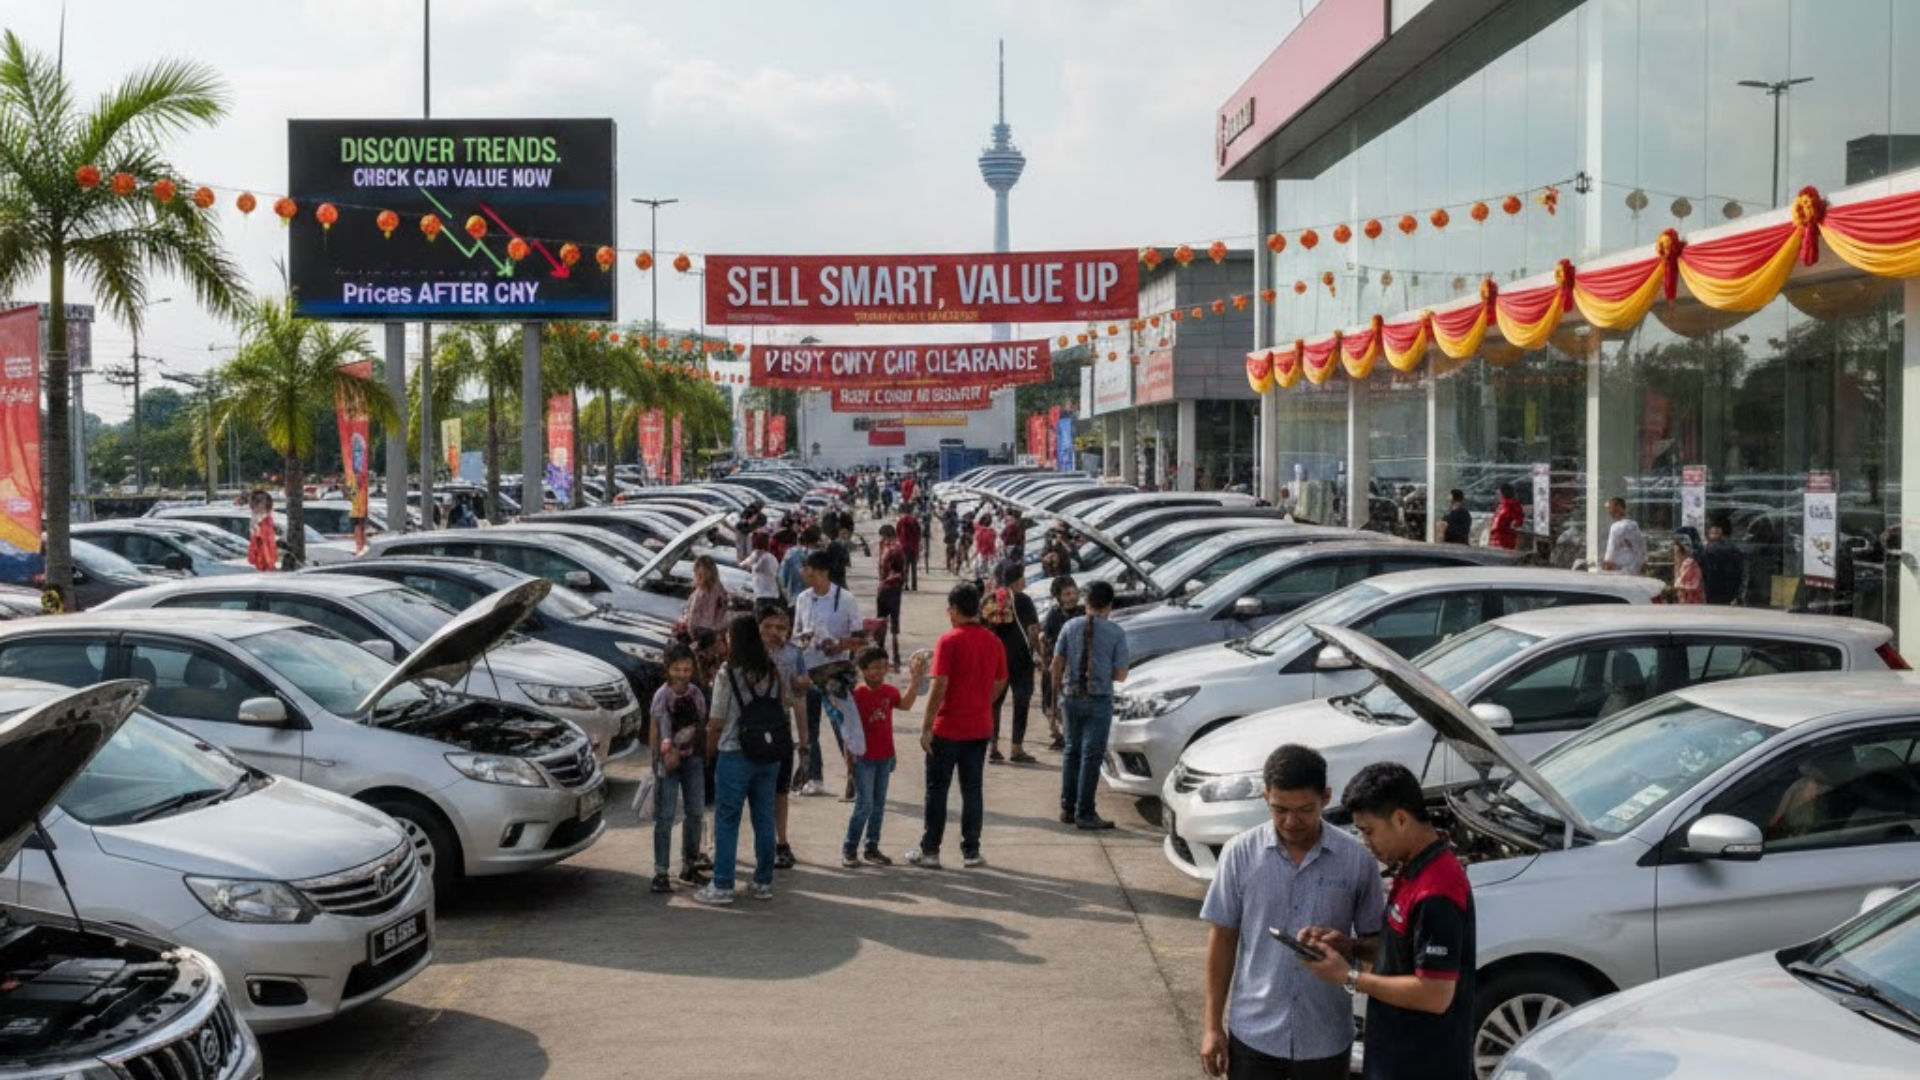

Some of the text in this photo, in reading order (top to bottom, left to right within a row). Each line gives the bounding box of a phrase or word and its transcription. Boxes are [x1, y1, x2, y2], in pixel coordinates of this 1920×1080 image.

[340, 137, 561, 163] DISCOVER TRENDS.
[413, 168, 449, 187] CAR
[452, 168, 508, 187] VALUE
[343, 281, 539, 304] Prices AFTER CNY
[727, 261, 1119, 309] SELL SMART, VALUE UP
